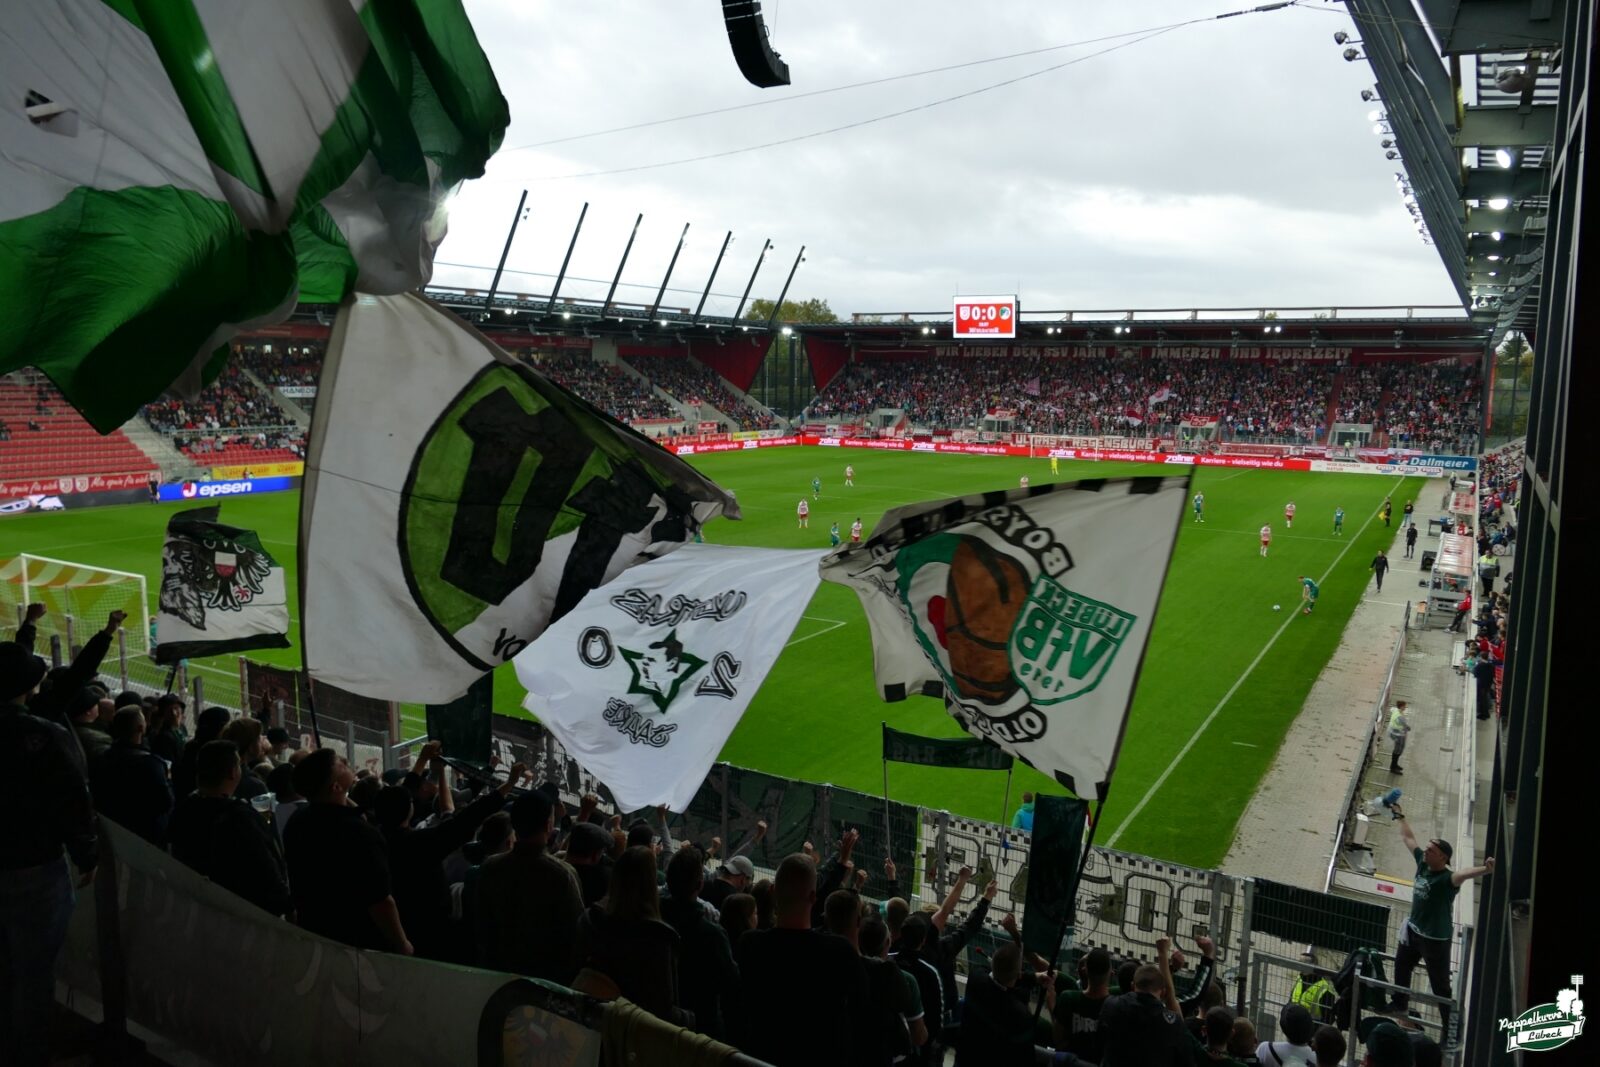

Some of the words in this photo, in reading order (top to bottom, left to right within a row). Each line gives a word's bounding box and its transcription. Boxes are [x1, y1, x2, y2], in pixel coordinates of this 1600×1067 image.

[971, 306, 997, 320] 0:0
[935, 346, 959, 357] WIR
[963, 346, 1008, 357] LIEBEN
[1044, 346, 1069, 357] SSV
[1072, 346, 1107, 357] JAHN
[1229, 347, 1261, 360] UND
[1265, 347, 1353, 361] JEDERZEIT
[1072, 437, 1154, 450] REGENSBURG
[1200, 457, 1226, 465] Karriere
[1231, 458, 1261, 467] vielseitig
[1410, 456, 1469, 469] Dallmeier
